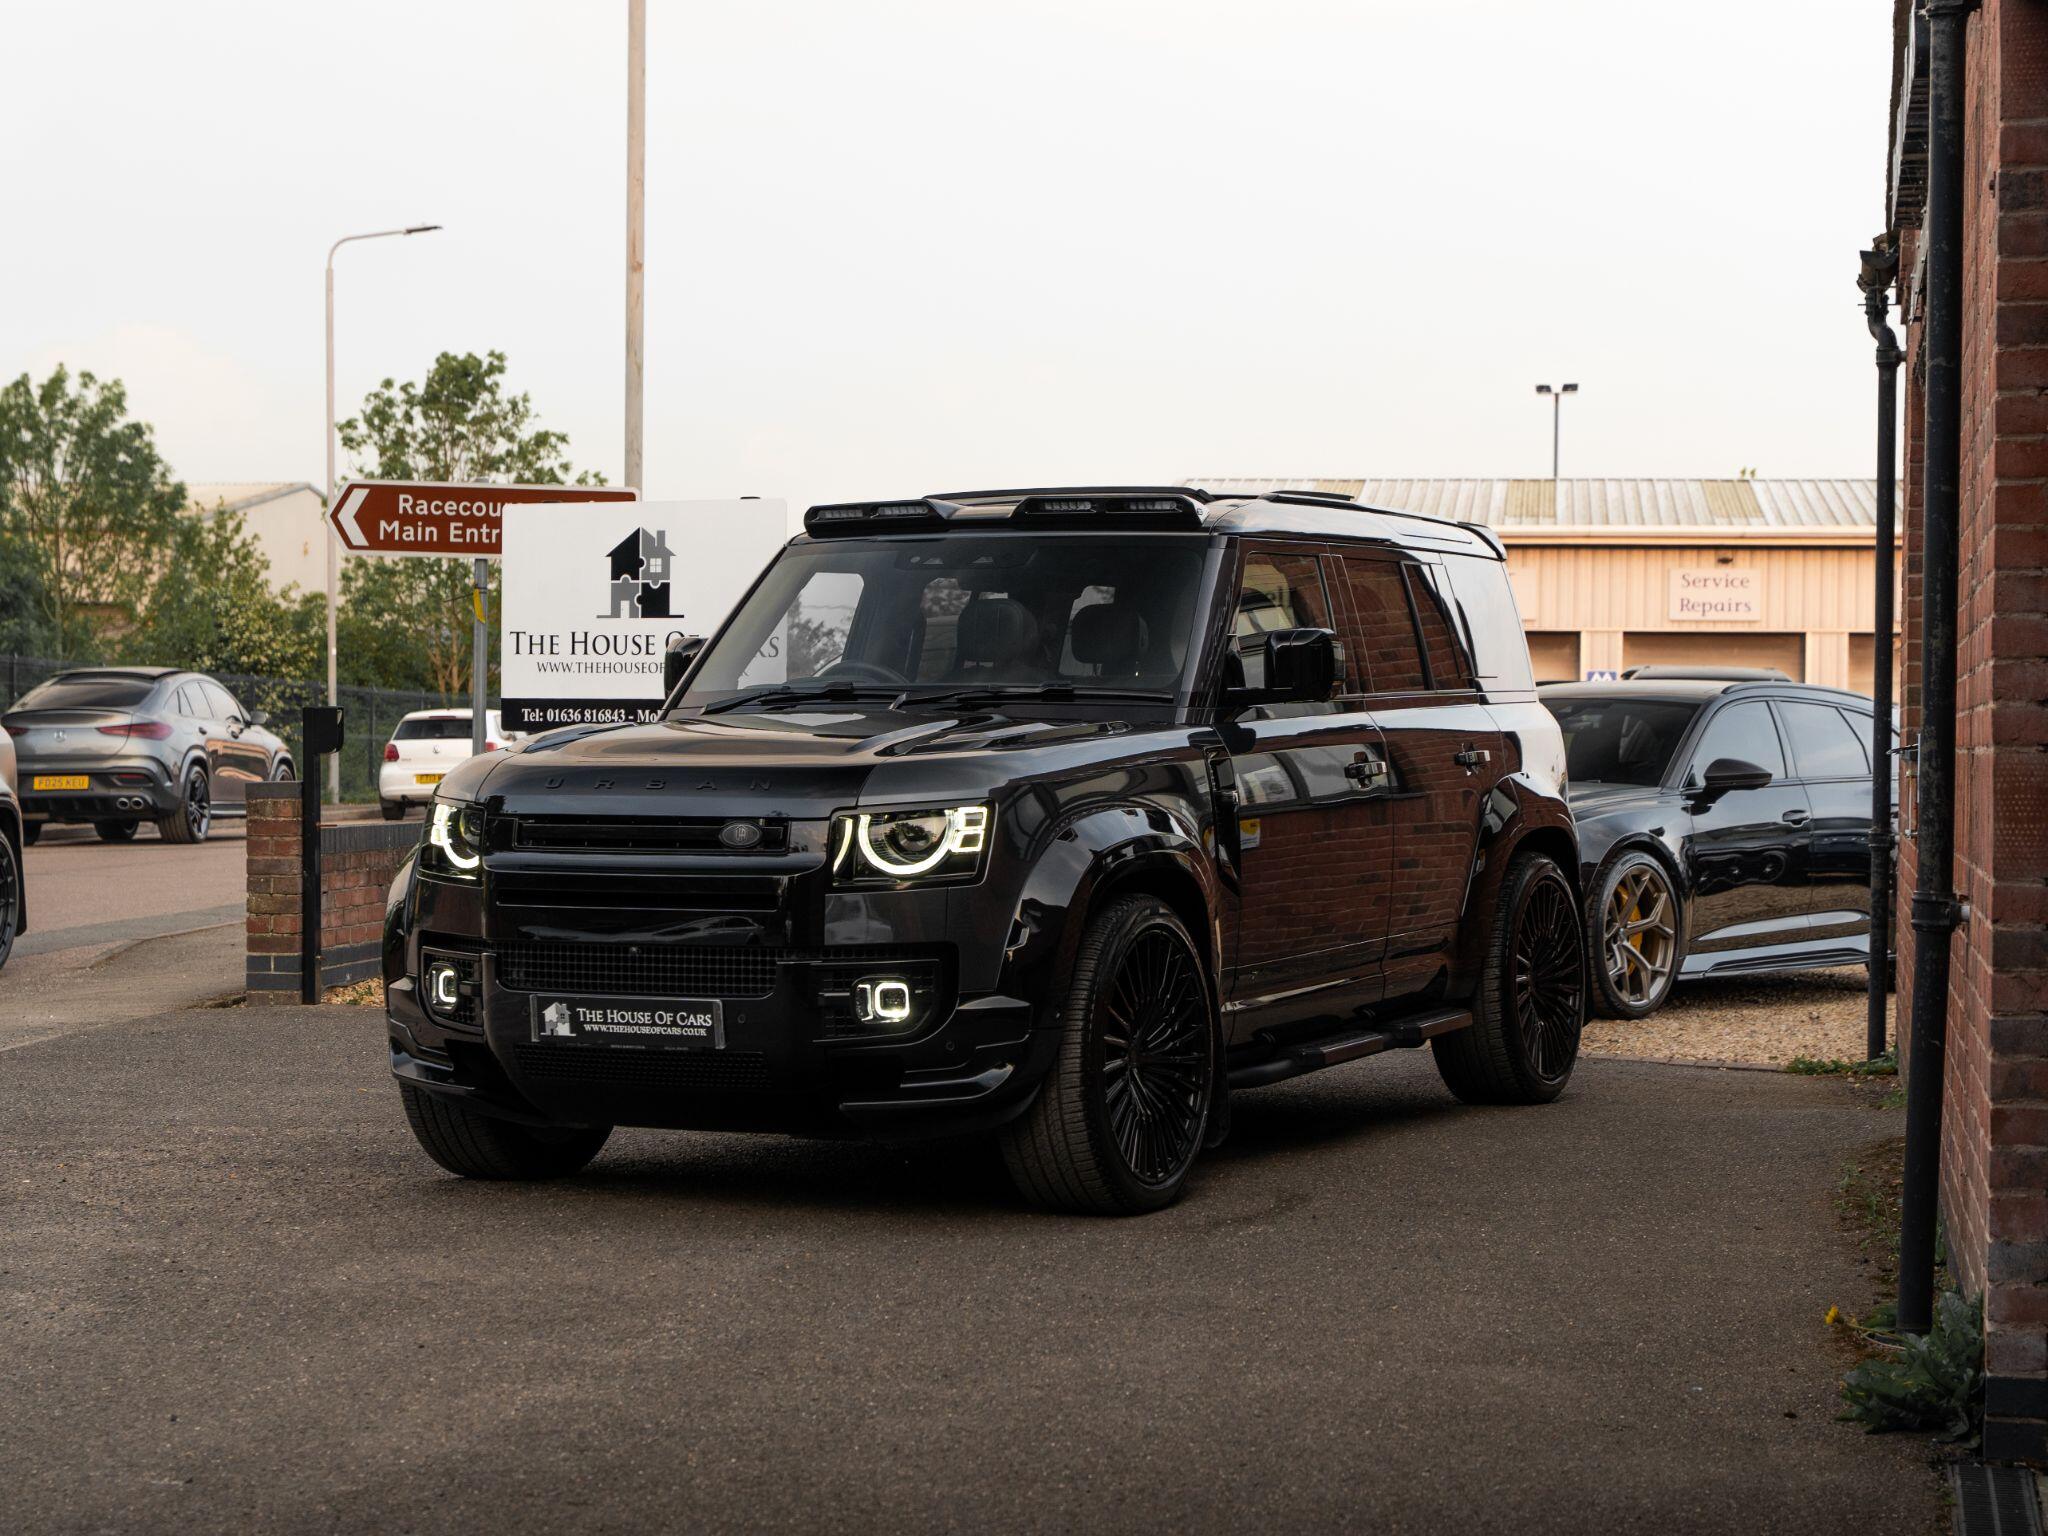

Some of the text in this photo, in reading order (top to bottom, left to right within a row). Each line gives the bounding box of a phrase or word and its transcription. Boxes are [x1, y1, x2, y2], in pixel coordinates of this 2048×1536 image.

[398, 493, 502, 518] Racecou
[379, 519, 501, 544] Main Entr
[1681, 573, 1751, 589] Service
[1679, 598, 1752, 617] Repairs
[509, 631, 560, 655] THE
[570, 631, 656, 656] HOUSE
[536, 661, 665, 674] WWW.THEHOUSEOF
[521, 708, 544, 722] Tel:
[546, 708, 582, 723] 01636
[583, 708, 626, 723] 816843
[637, 709, 661, 723] Mo
[544, 777, 773, 790] URBAN
[576, 1008, 713, 1027] THE HOUSE OF CARS
